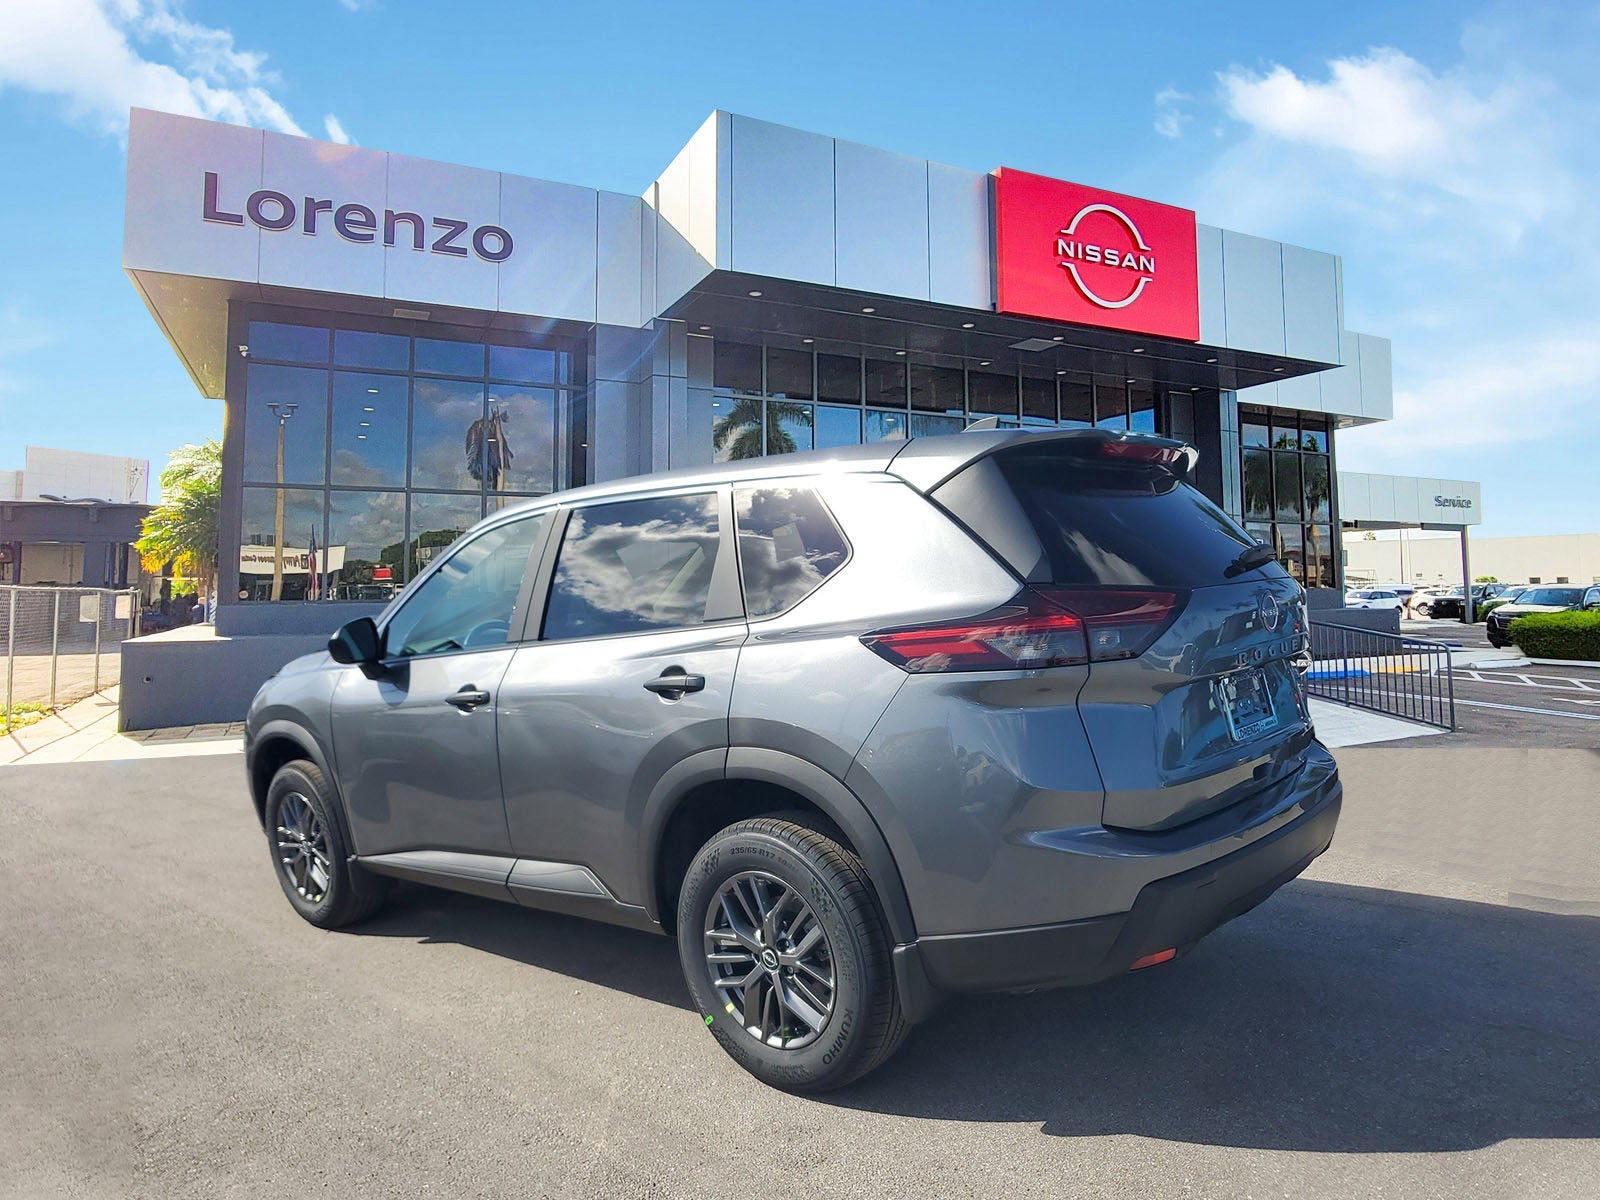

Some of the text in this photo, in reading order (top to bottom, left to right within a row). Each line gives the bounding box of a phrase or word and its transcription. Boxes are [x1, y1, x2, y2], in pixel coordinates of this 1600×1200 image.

[202, 171, 515, 262] Lorenzo
[1057, 238, 1155, 273] NISSAN
[1435, 495, 1472, 508] Service
[1237, 639, 1299, 665] ROGUE
[730, 846, 776, 860] 235/65 R17
[822, 1007, 854, 1065] KUMHO
